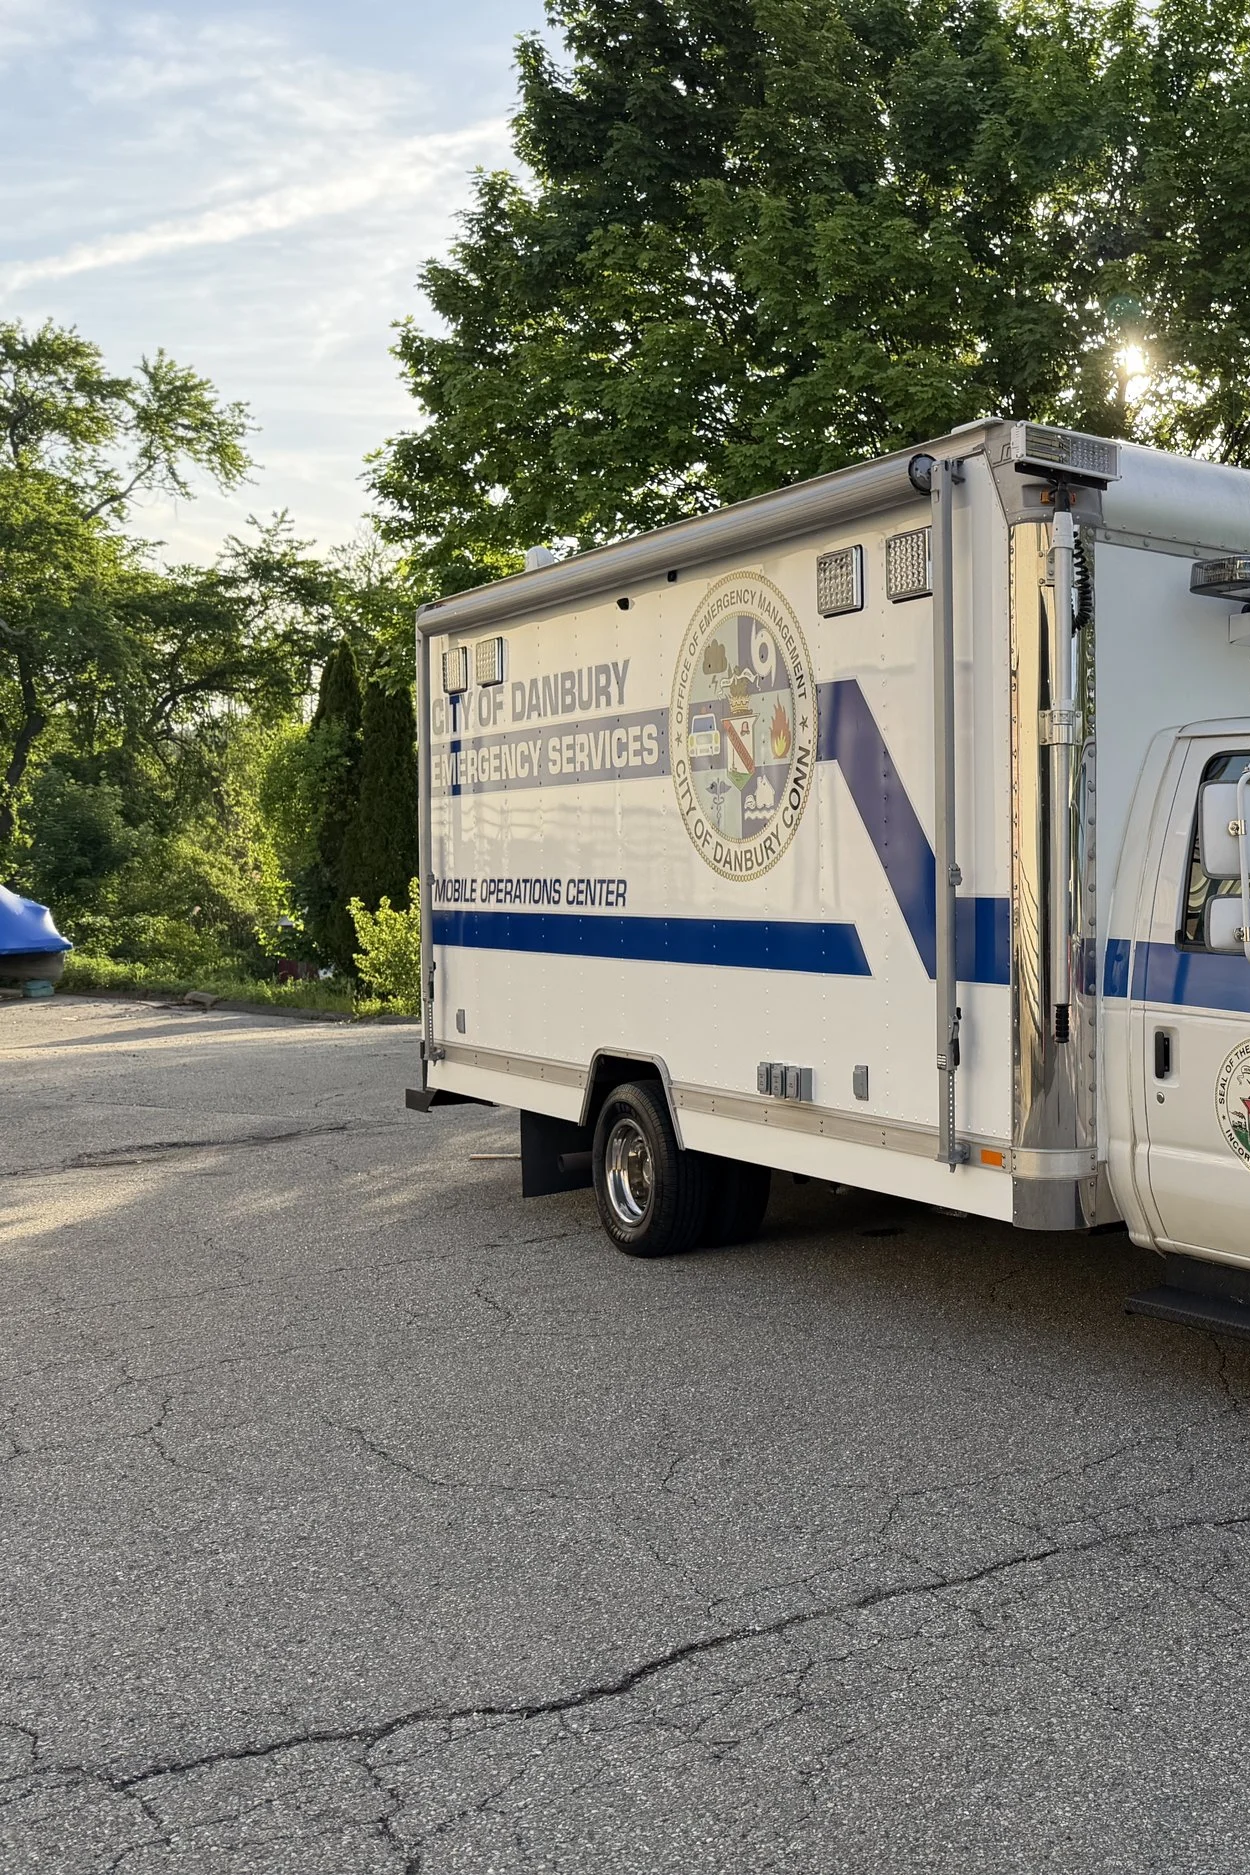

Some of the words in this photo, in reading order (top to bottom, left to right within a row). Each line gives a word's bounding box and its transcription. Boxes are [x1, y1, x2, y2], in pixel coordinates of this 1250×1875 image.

[676, 658, 691, 724] OFFICE
[688, 632, 702, 657] OF
[698, 588, 757, 635] EMERGENCY
[757, 590, 807, 700] MANAGEMENT
[432, 694, 474, 736] CITY
[478, 683, 504, 728] OF
[511, 659, 631, 722] DANBURY
[432, 739, 542, 788] EMERGENCY
[548, 724, 659, 776] SERVICES
[675, 759, 697, 816] CITY
[694, 818, 713, 849] OF
[713, 824, 782, 873] DANBURY
[782, 739, 812, 829] CONN.
[434, 878, 477, 904] MOBILE
[480, 878, 561, 905] OPERATIONS
[565, 879, 628, 907] CENTER
[1218, 1076, 1229, 1105] SEAL
[1226, 1058, 1234, 1074] OF
[1234, 1044, 1250, 1061] THE
